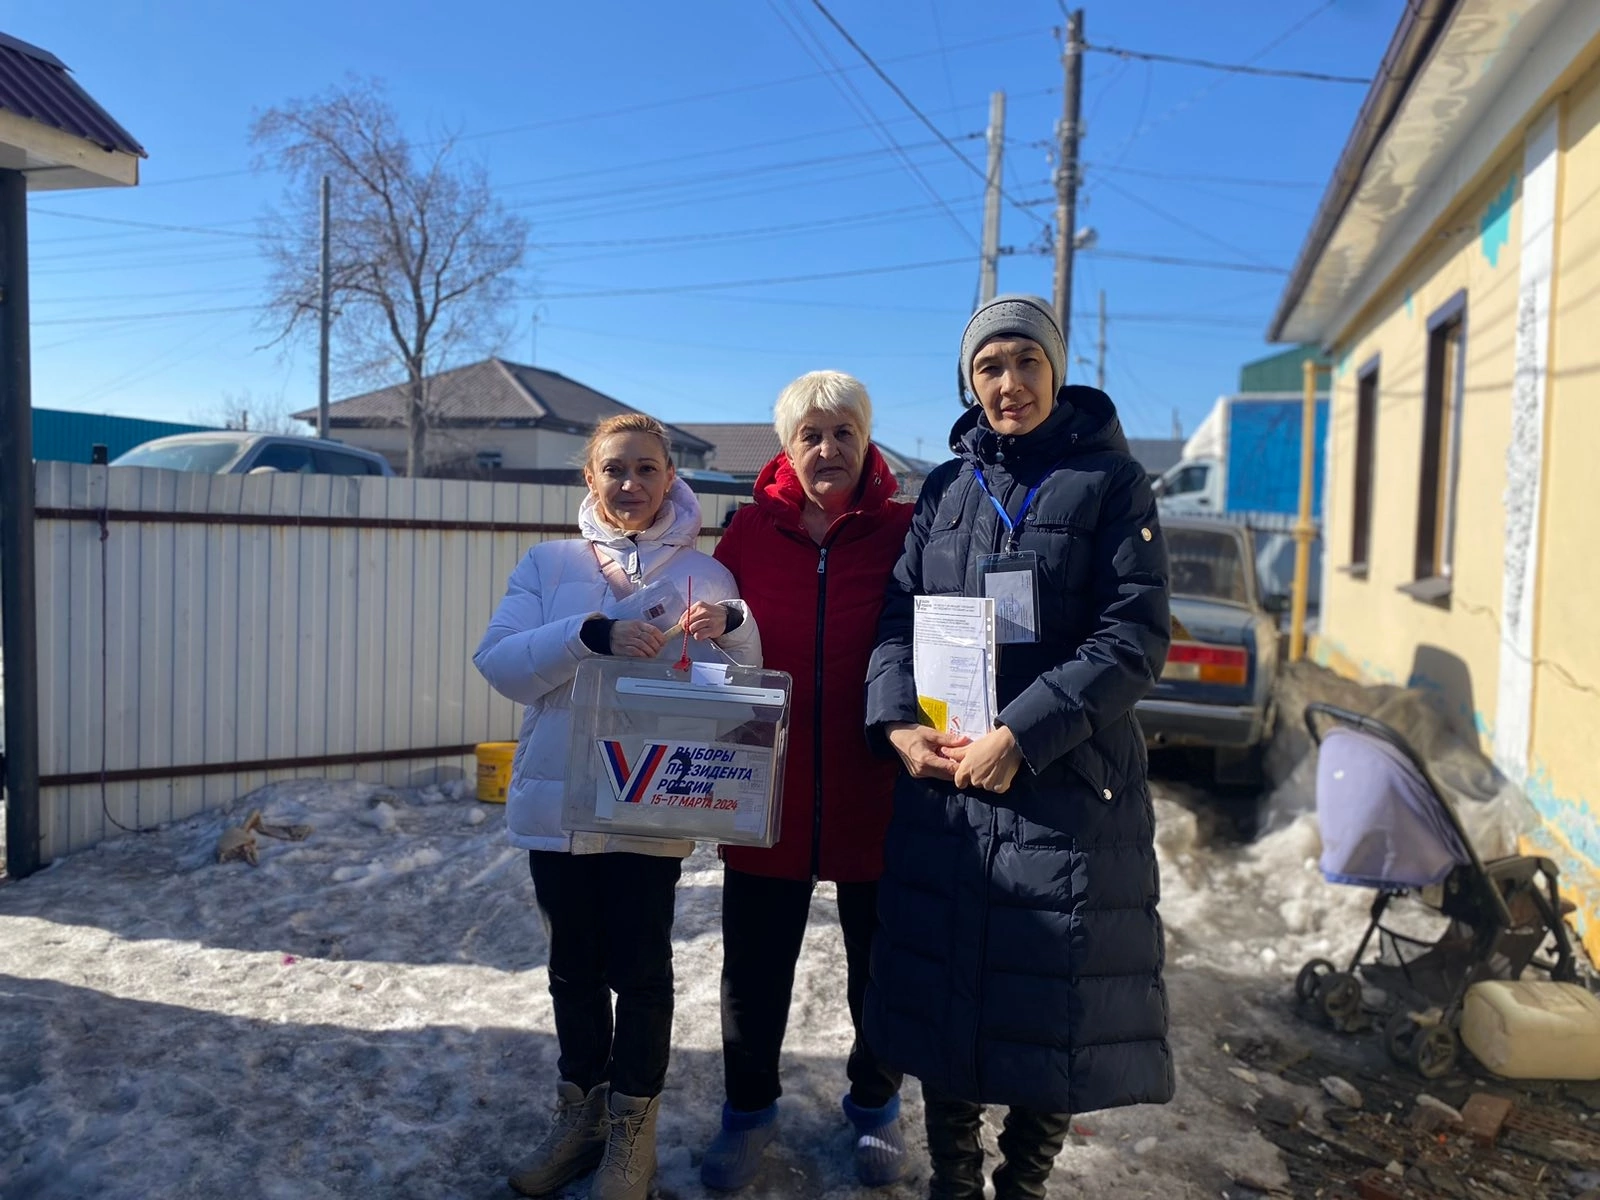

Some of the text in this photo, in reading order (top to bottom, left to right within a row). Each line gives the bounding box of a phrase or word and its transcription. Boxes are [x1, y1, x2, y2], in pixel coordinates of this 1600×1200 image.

[674, 746, 736, 762] ВЫБОРЫ
[665, 763, 753, 780] ПРЕЗИДЕНТА
[667, 752, 692, 795] 2
[679, 796, 713, 809] МАРТА
[713, 798, 738, 811] 2024
